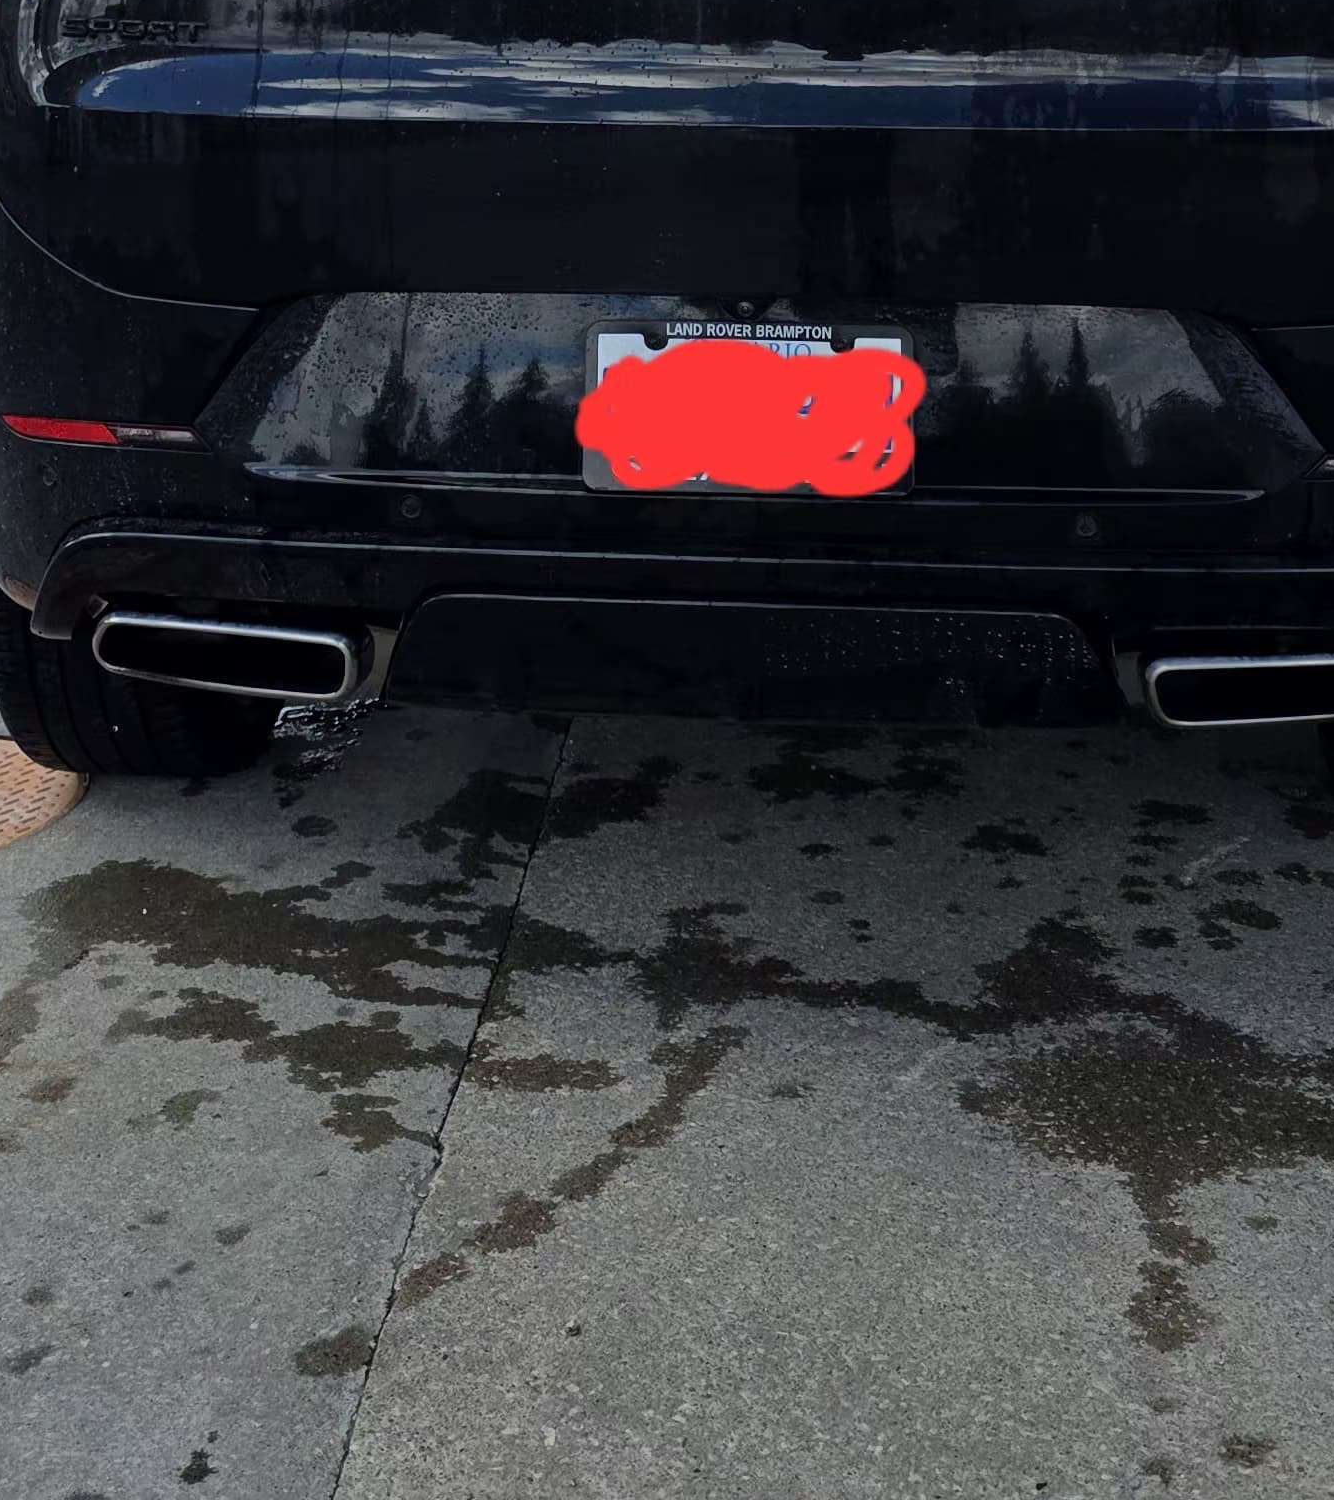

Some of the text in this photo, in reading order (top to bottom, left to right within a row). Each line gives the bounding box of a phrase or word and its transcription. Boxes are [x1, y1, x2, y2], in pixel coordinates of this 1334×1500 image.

[61, 19, 209, 44] SPORT
[666, 322, 833, 340] LAND ROVER BRAMPTON
